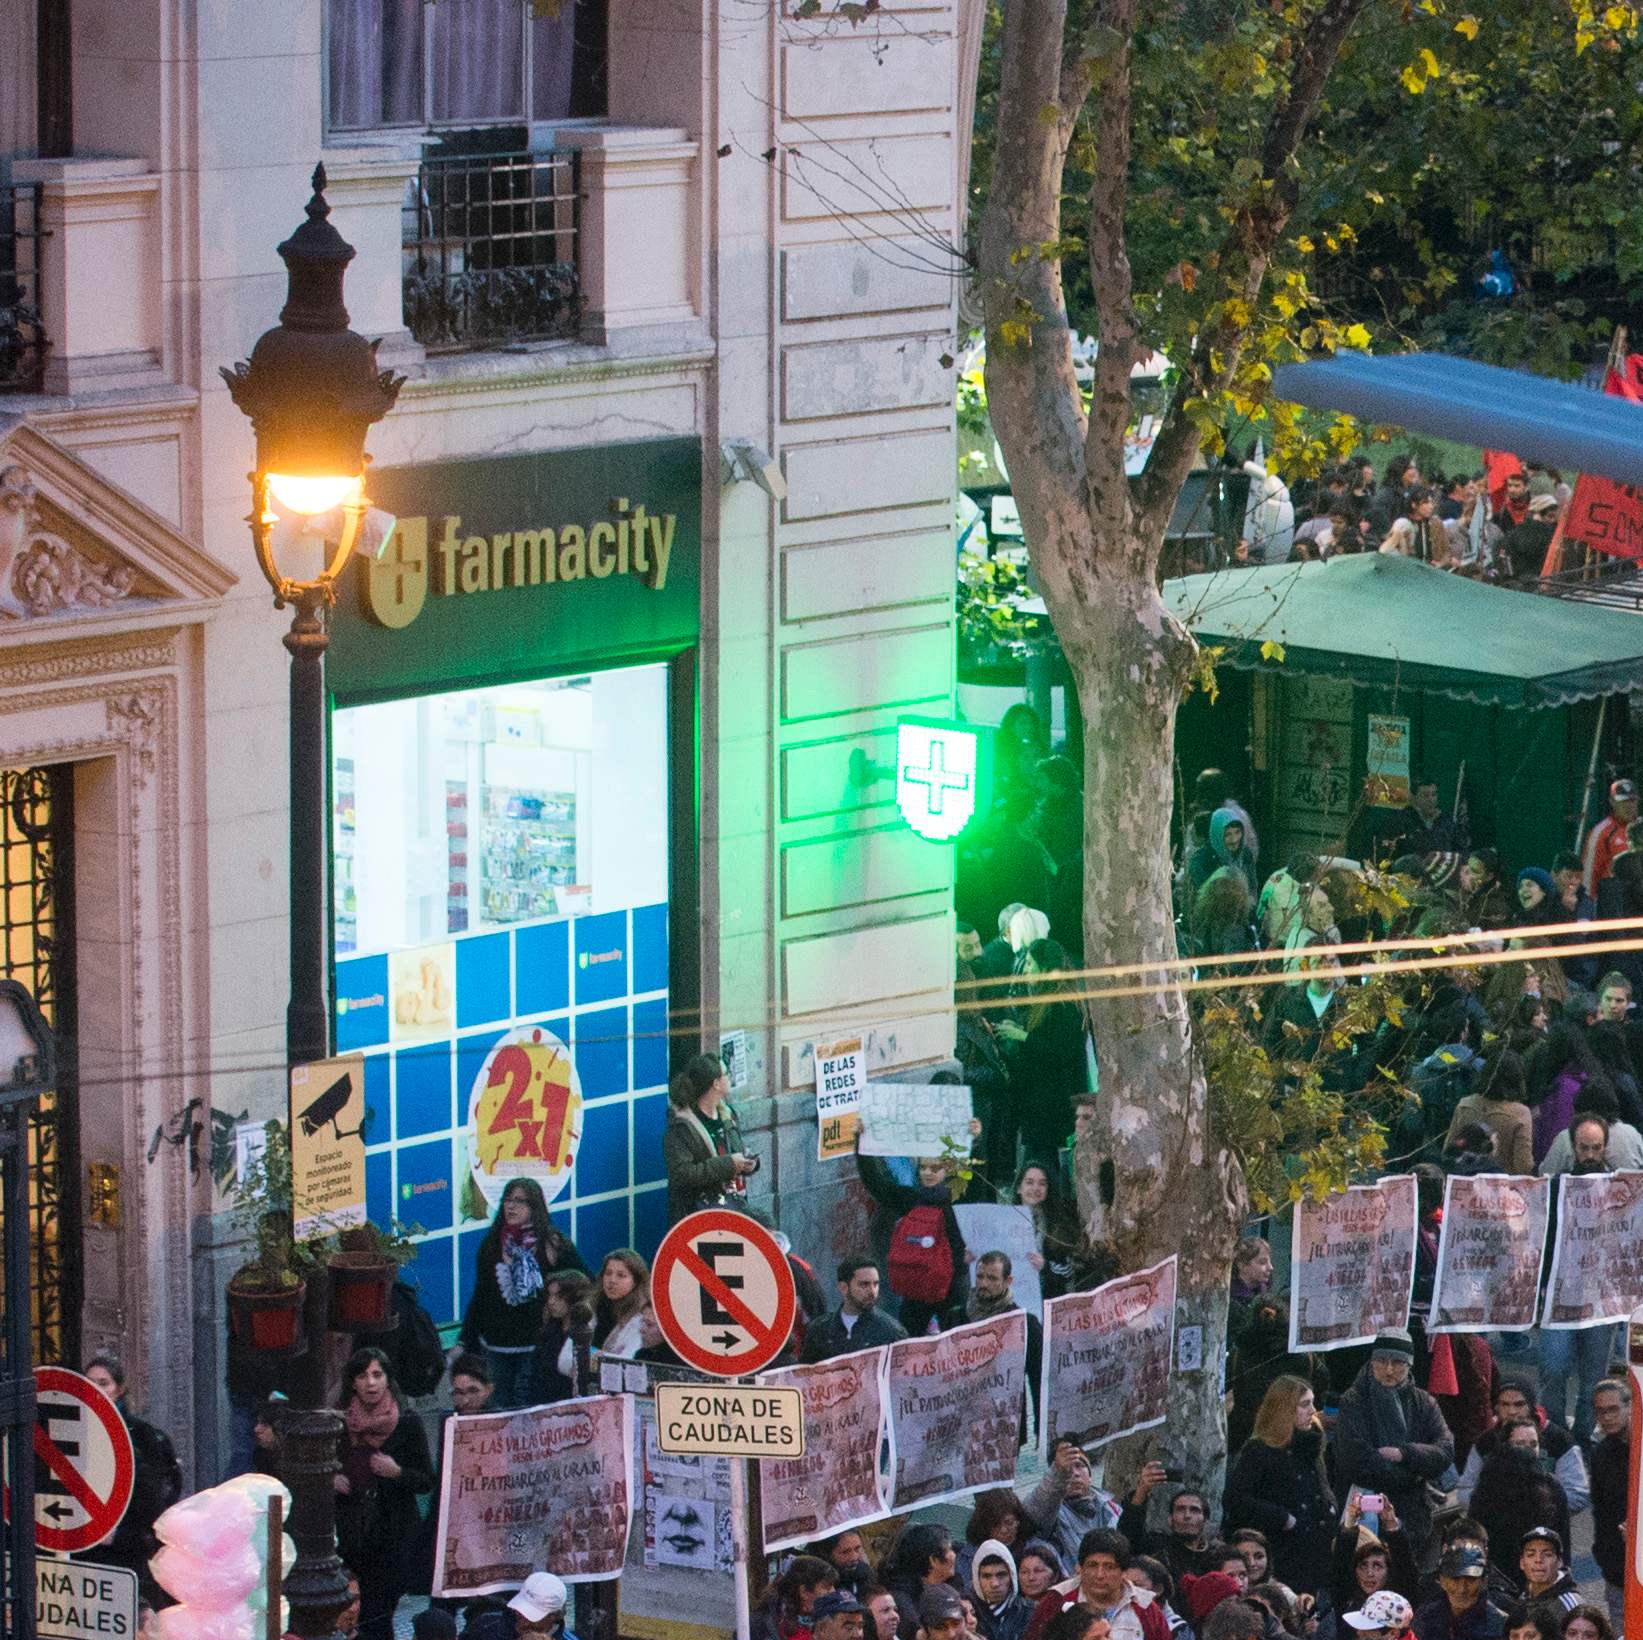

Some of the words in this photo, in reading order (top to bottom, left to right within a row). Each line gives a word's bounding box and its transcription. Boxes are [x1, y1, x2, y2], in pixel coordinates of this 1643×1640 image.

[438, 496, 677, 593] farmacity
[824, 1058, 836, 1074] DE
[837, 1056, 856, 1072] LAS
[825, 1075, 856, 1092] REDES
[314, 1149, 344, 1166] Espacio
[305, 1160, 353, 1181] monitoreado
[307, 1179, 321, 1194] por
[680, 1395, 745, 1420] ZONA
[752, 1397, 784, 1419] DE
[668, 1421, 795, 1447] CAUDALES
[79, 1577, 113, 1602] DE
